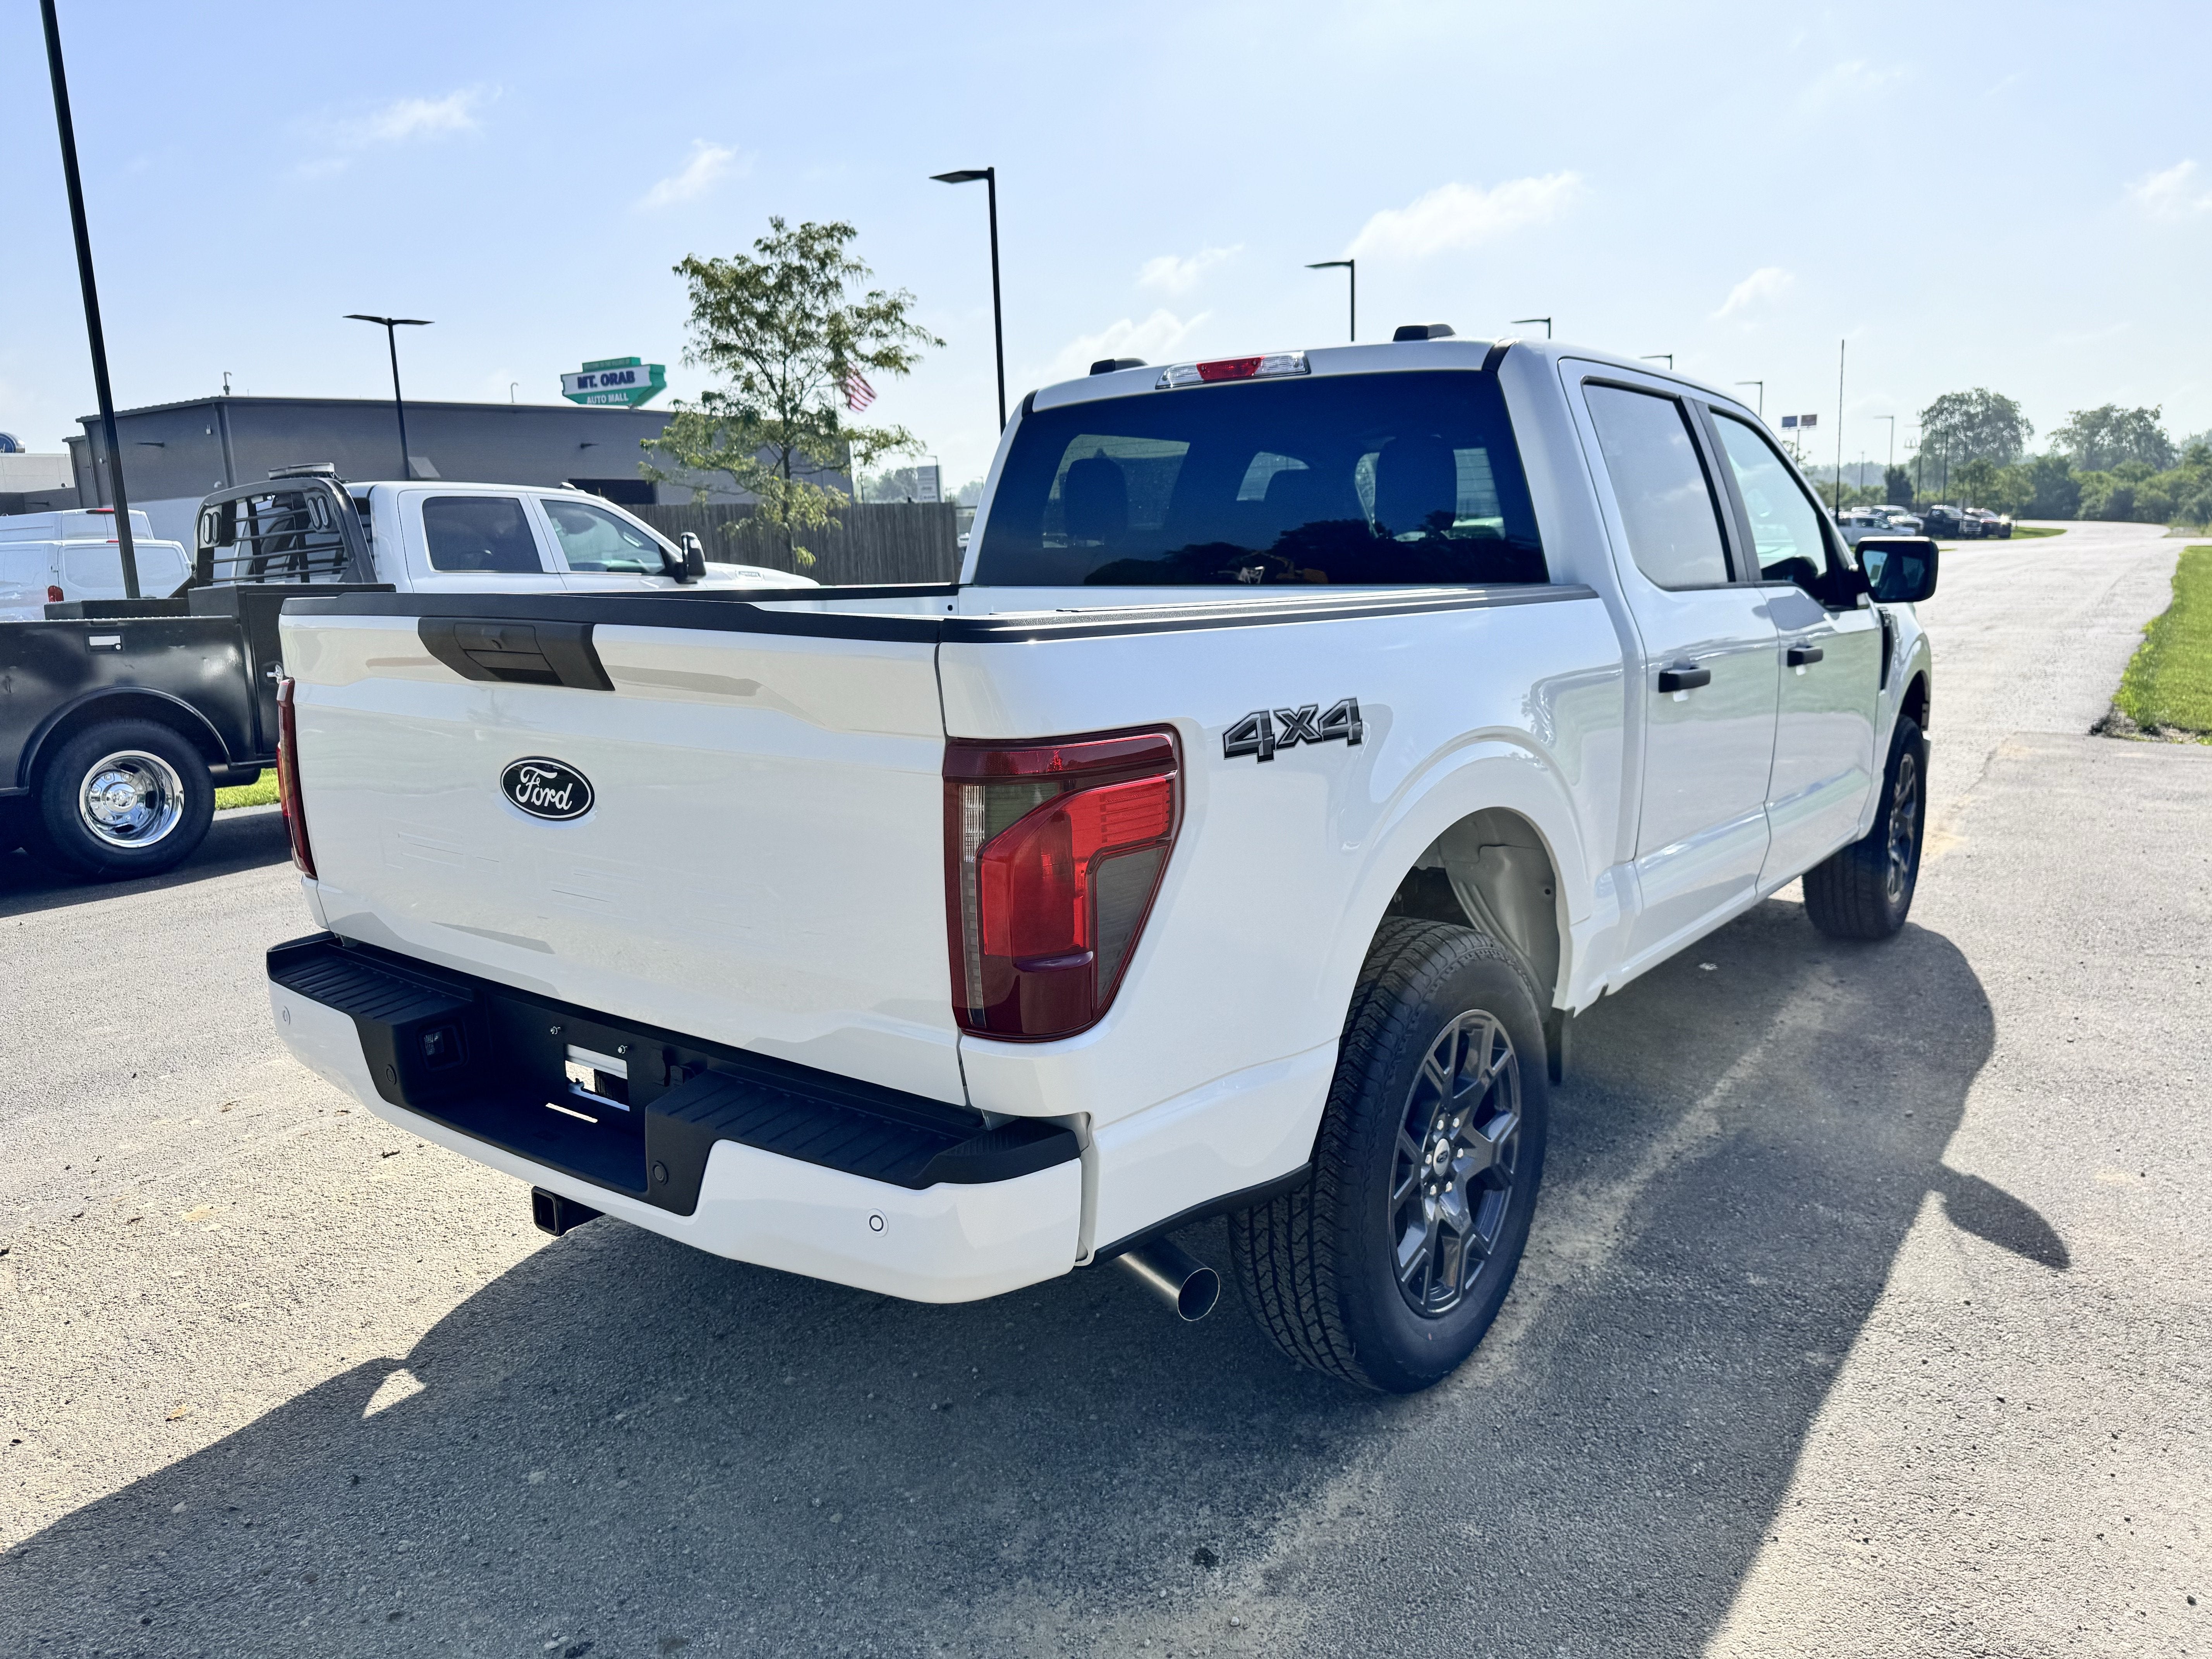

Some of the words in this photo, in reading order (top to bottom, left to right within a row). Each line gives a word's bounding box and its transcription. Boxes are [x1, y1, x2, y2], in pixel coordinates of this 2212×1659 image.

[577, 374, 598, 389] MT.
[600, 370, 635, 386] ORAB
[587, 394, 606, 405] AUTO
[608, 392, 629, 403] MALL
[516, 766, 573, 810] Ford
